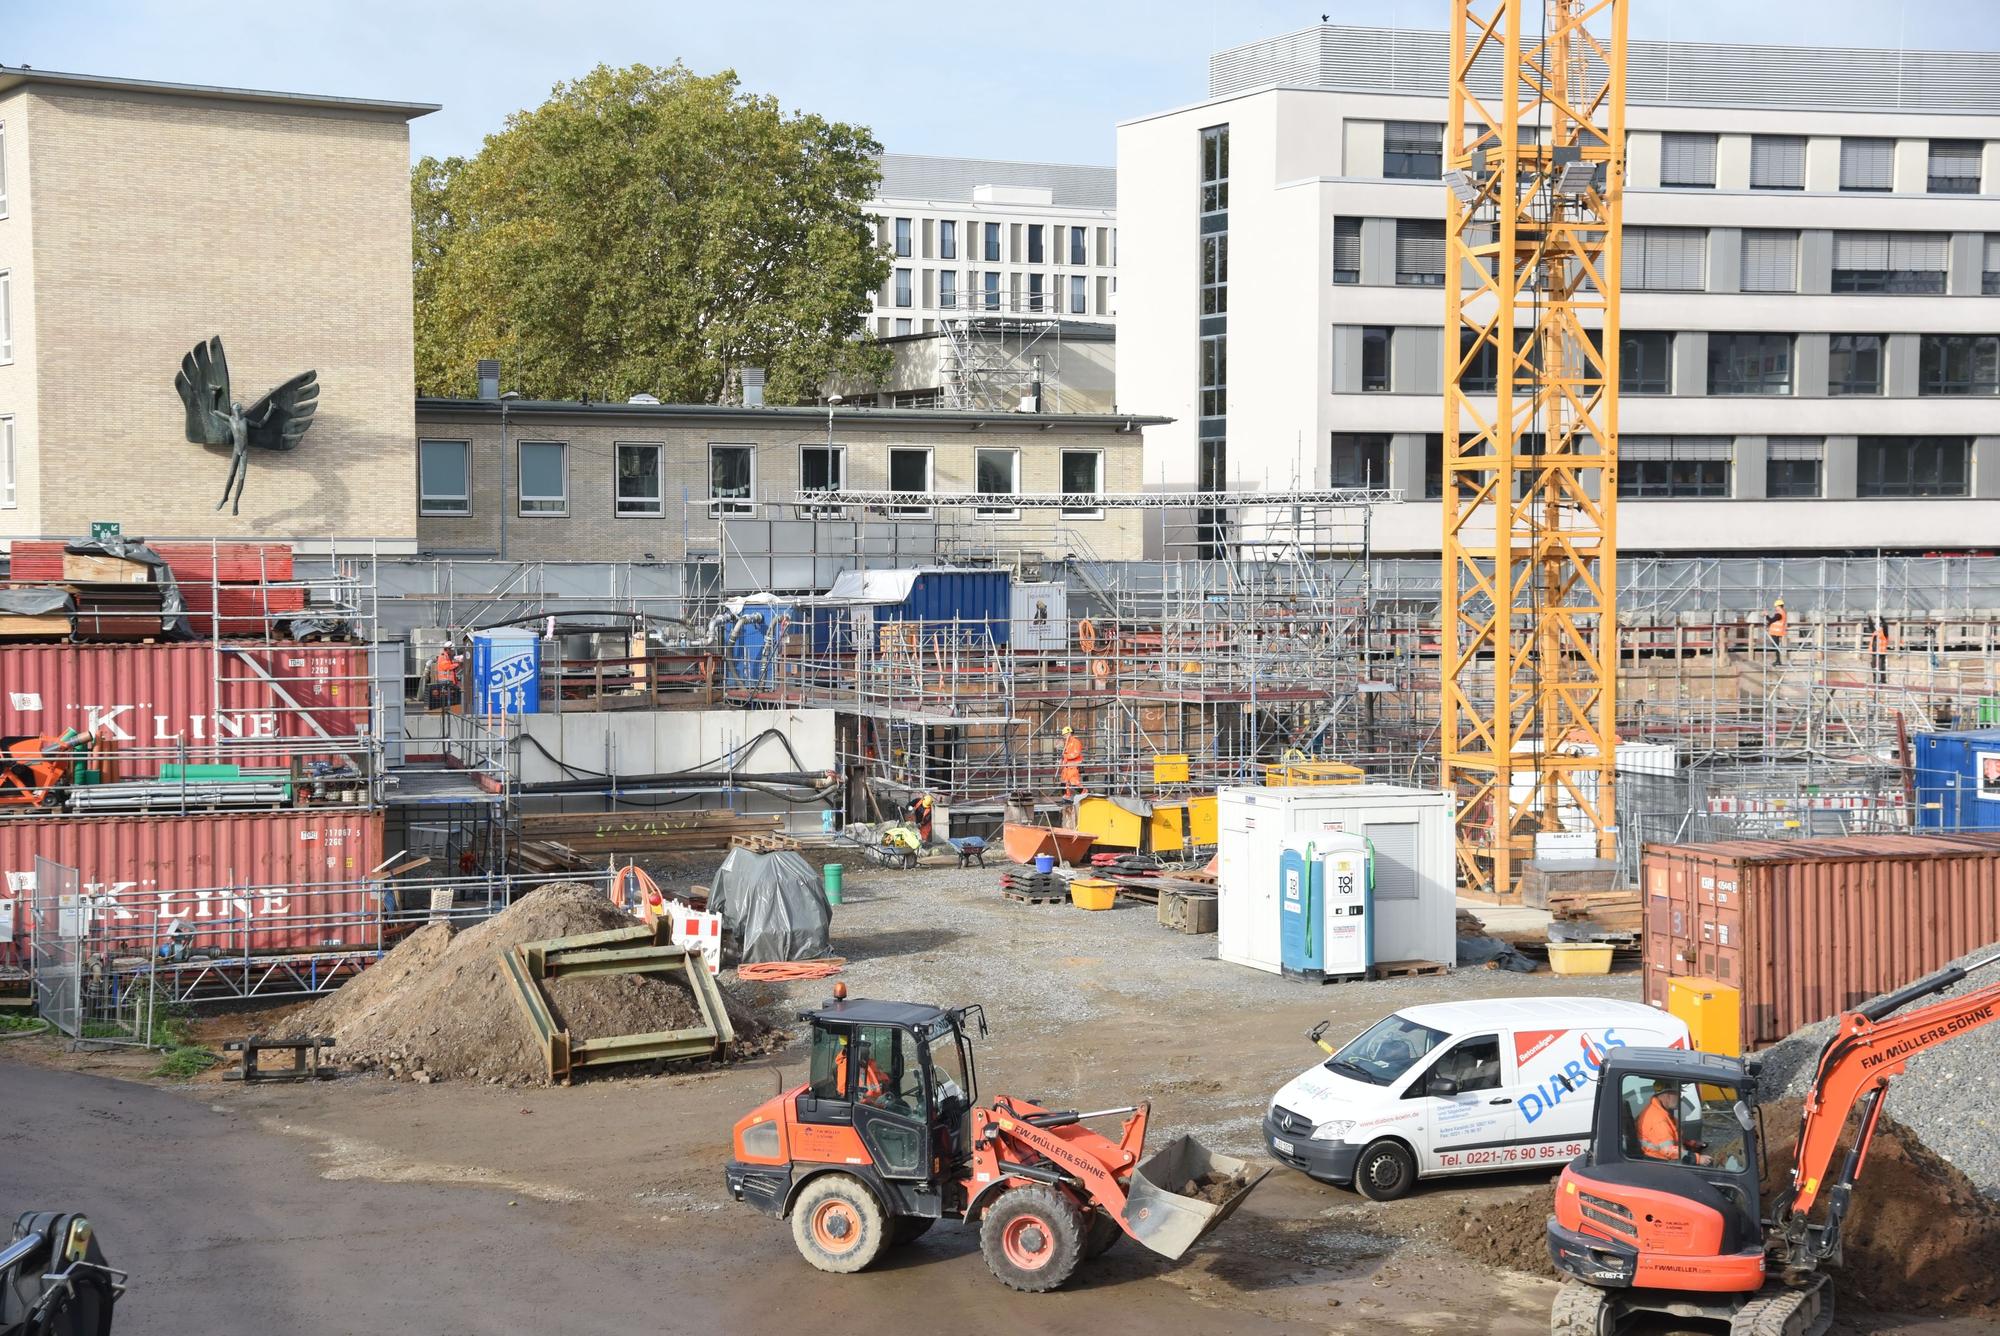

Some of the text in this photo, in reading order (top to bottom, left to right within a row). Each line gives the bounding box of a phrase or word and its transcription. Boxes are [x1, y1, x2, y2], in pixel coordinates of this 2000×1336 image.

[154, 714, 278, 739] LINE
[157, 887, 291, 919] LINE
[1519, 1033, 1555, 1063] Betonsägen
[1440, 1154, 1462, 1167] Tel.
[1521, 1148, 1536, 1159] 90
